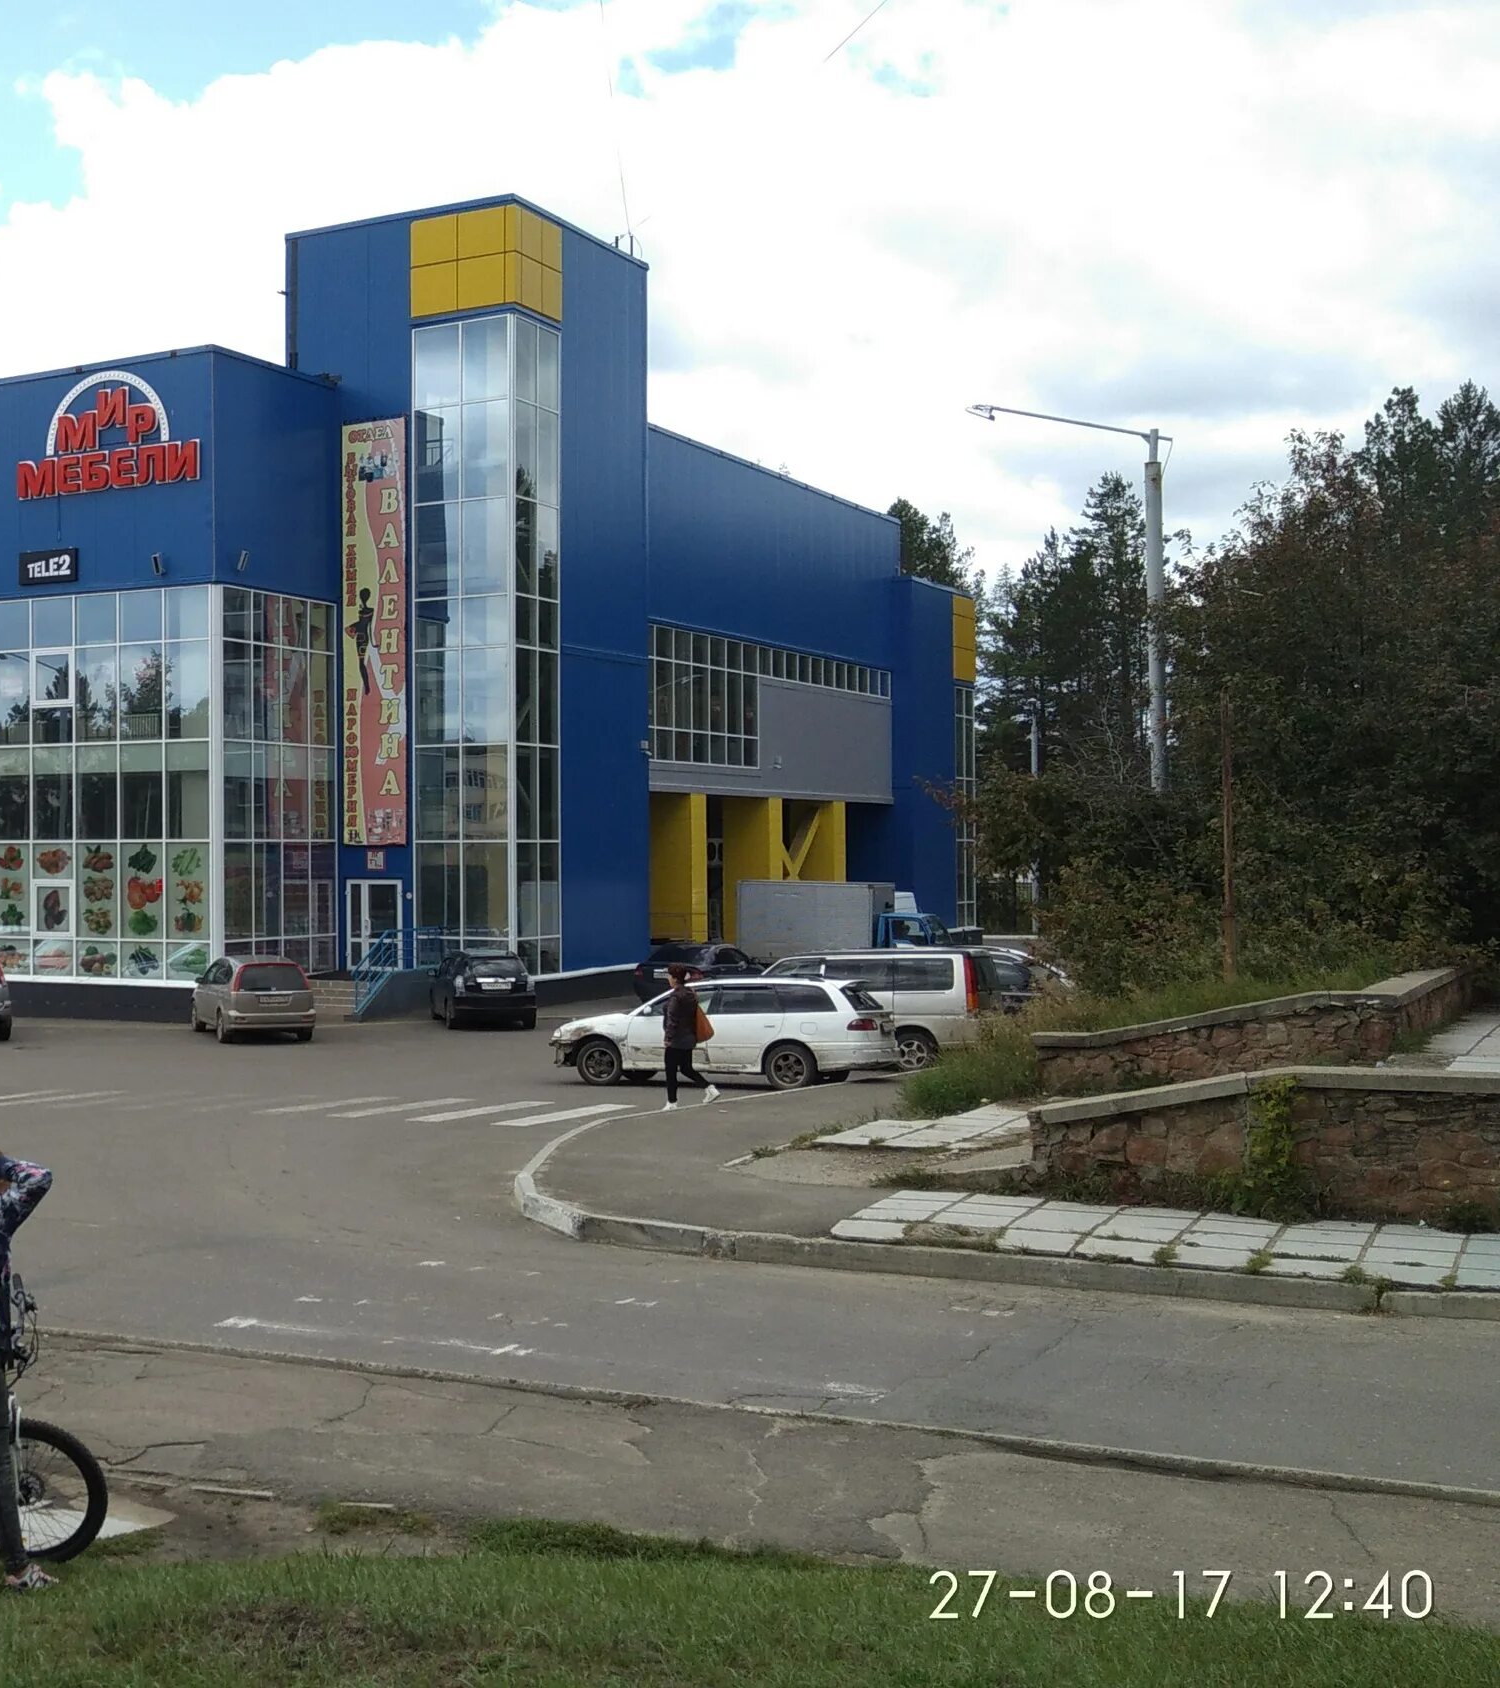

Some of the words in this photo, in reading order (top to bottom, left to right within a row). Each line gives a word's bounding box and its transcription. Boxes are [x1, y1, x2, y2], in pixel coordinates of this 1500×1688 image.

[17, 438, 200, 500] МЕБЕЛИ
[27, 554, 71, 578] TELE2
[377, 488, 400, 796] ВАЛЕНТИНА
